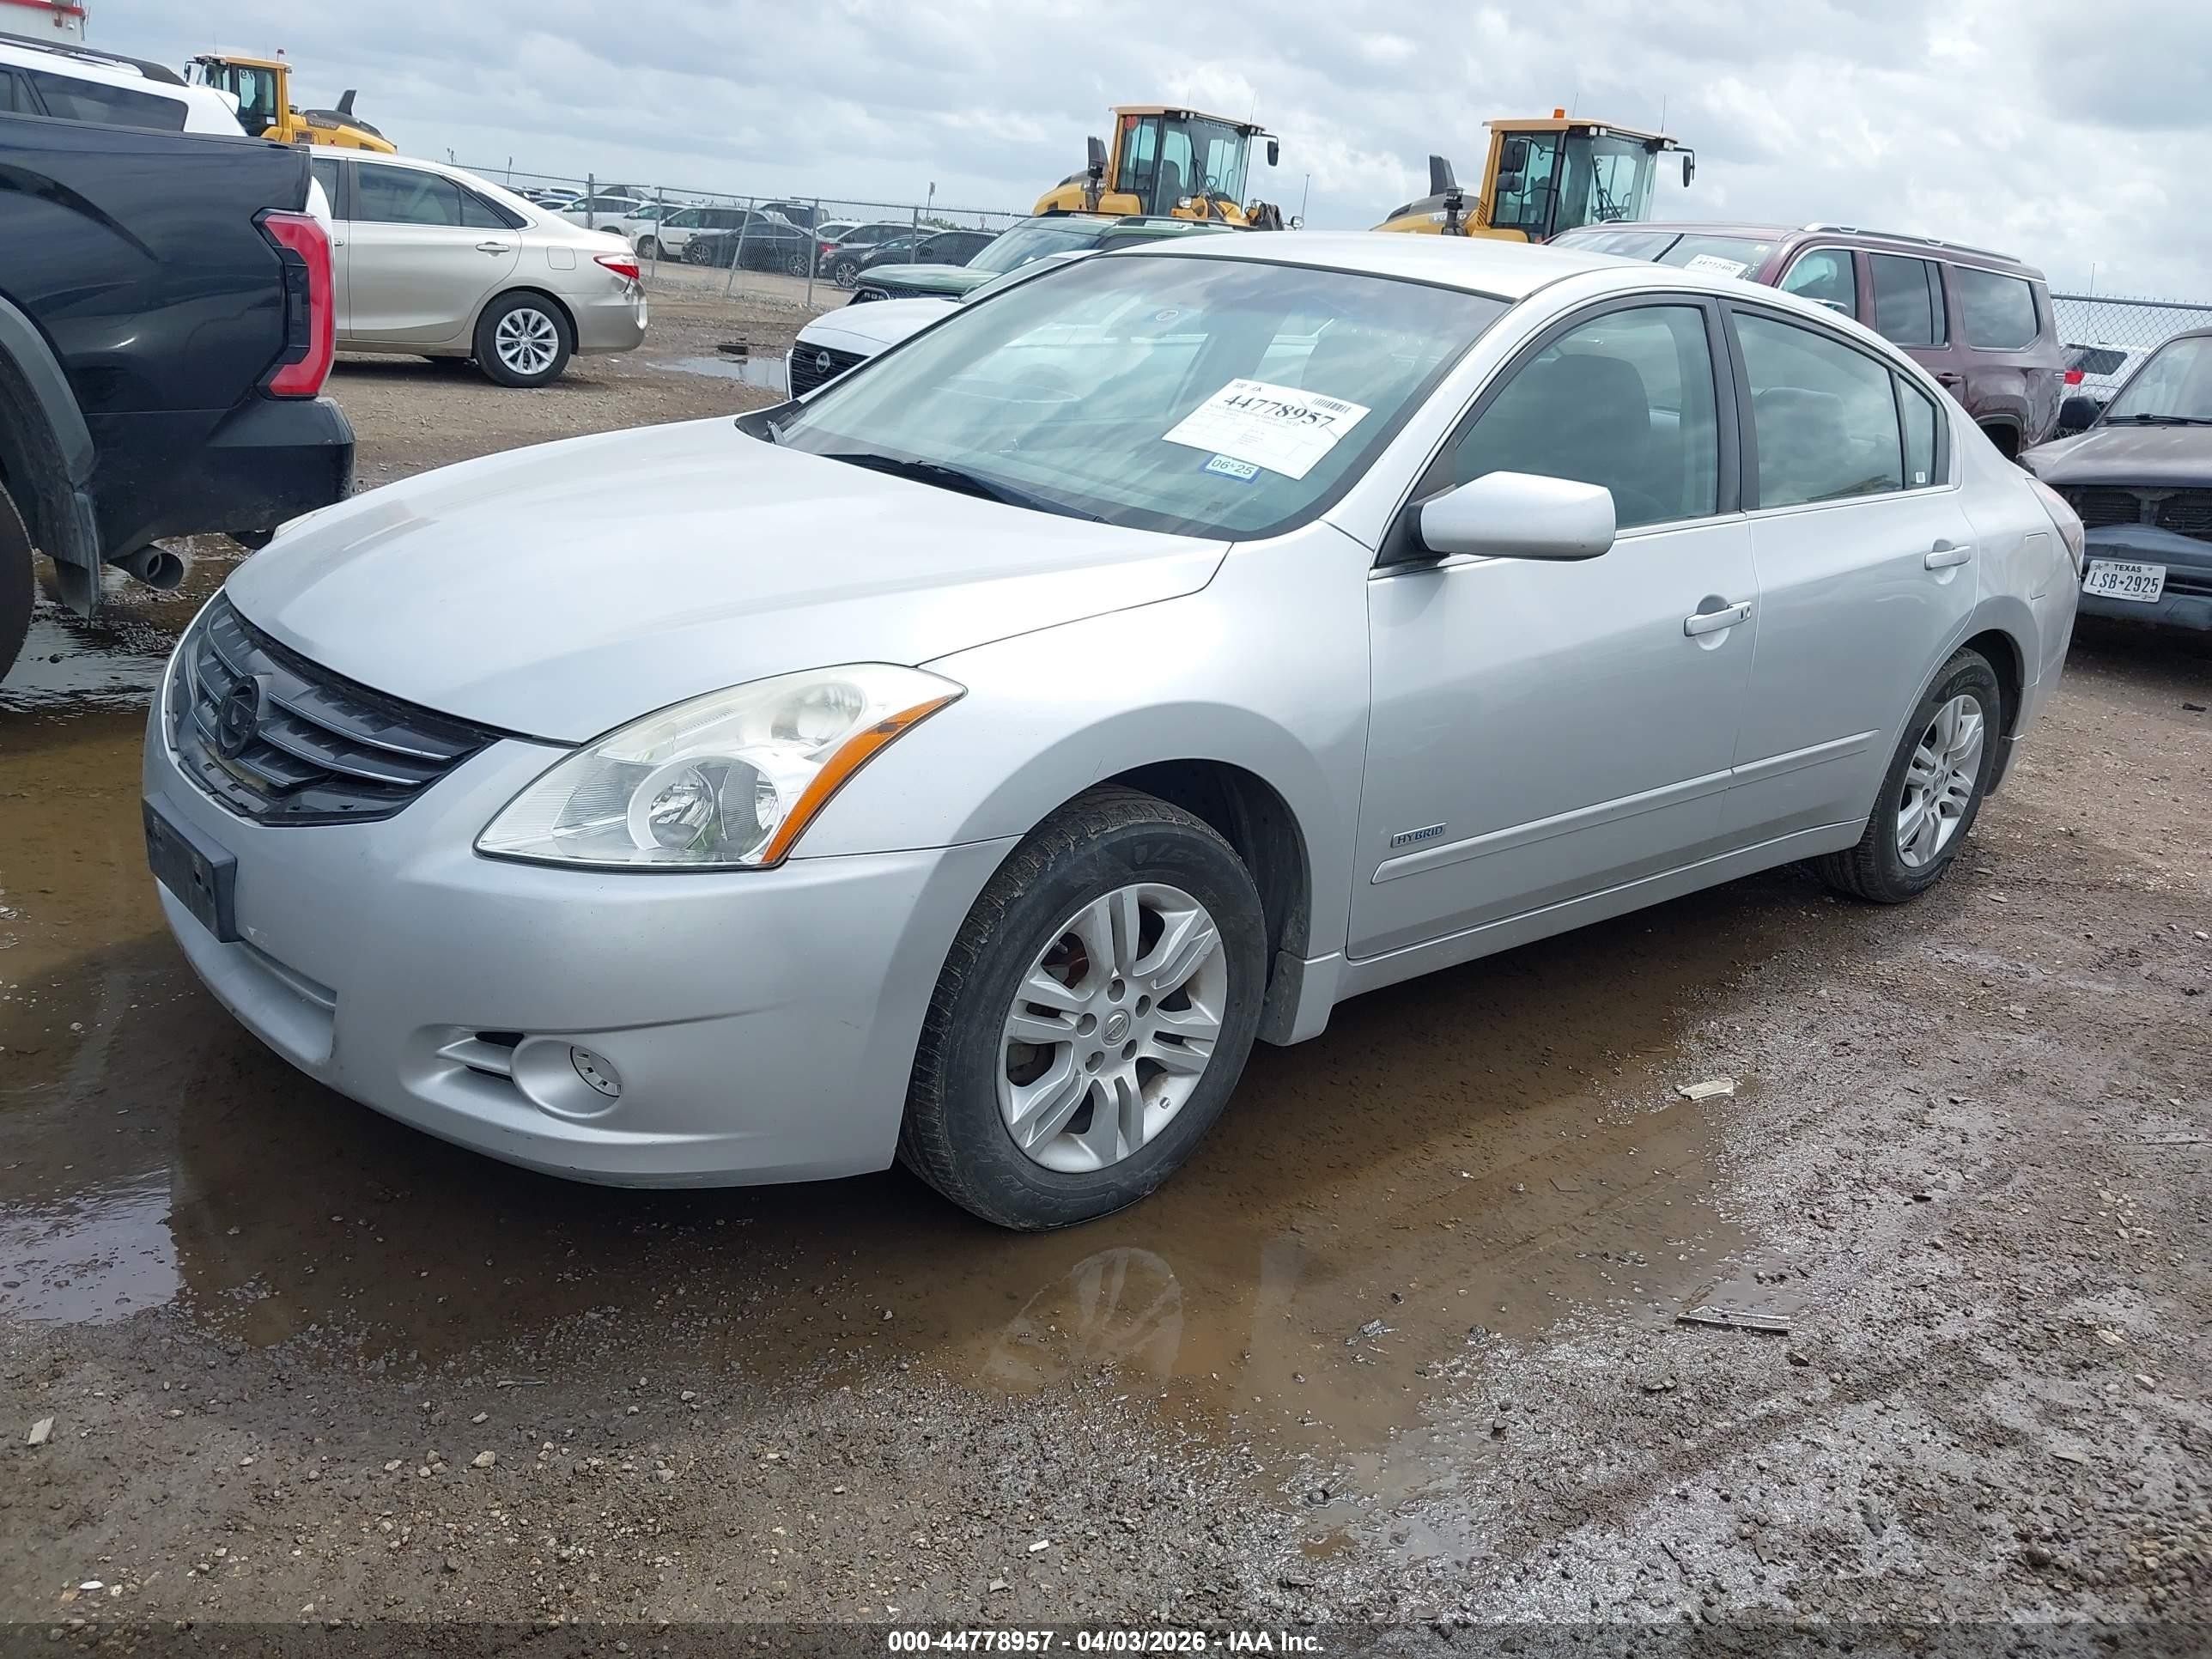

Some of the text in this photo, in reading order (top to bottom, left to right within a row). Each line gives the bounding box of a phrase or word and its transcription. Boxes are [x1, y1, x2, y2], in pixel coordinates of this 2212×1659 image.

[1224, 395, 1336, 428] 44778957
[2114, 564, 2142, 573] TEXAS
[1397, 825, 1443, 844] HYBRID
